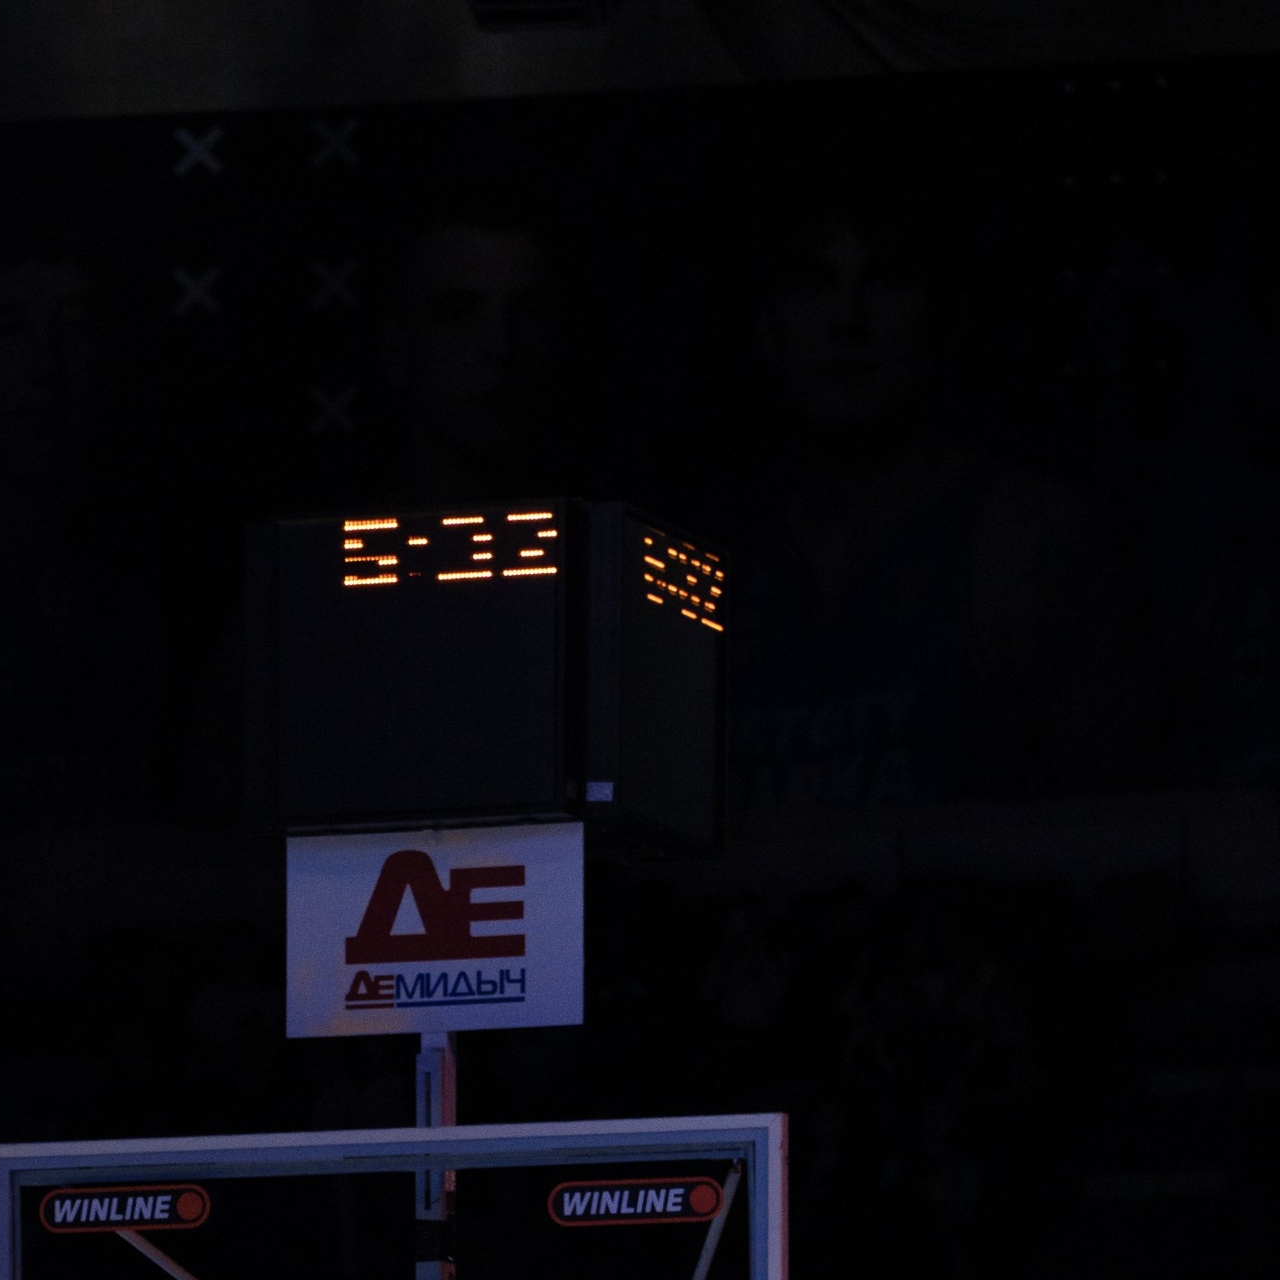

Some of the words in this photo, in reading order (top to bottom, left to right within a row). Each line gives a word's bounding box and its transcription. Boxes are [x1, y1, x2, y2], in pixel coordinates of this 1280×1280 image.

[345, 968, 526, 1002] ДЕМИДЫЧ
[53, 1195, 172, 1224] WINLINE
[563, 1187, 685, 1216] WINLINE
